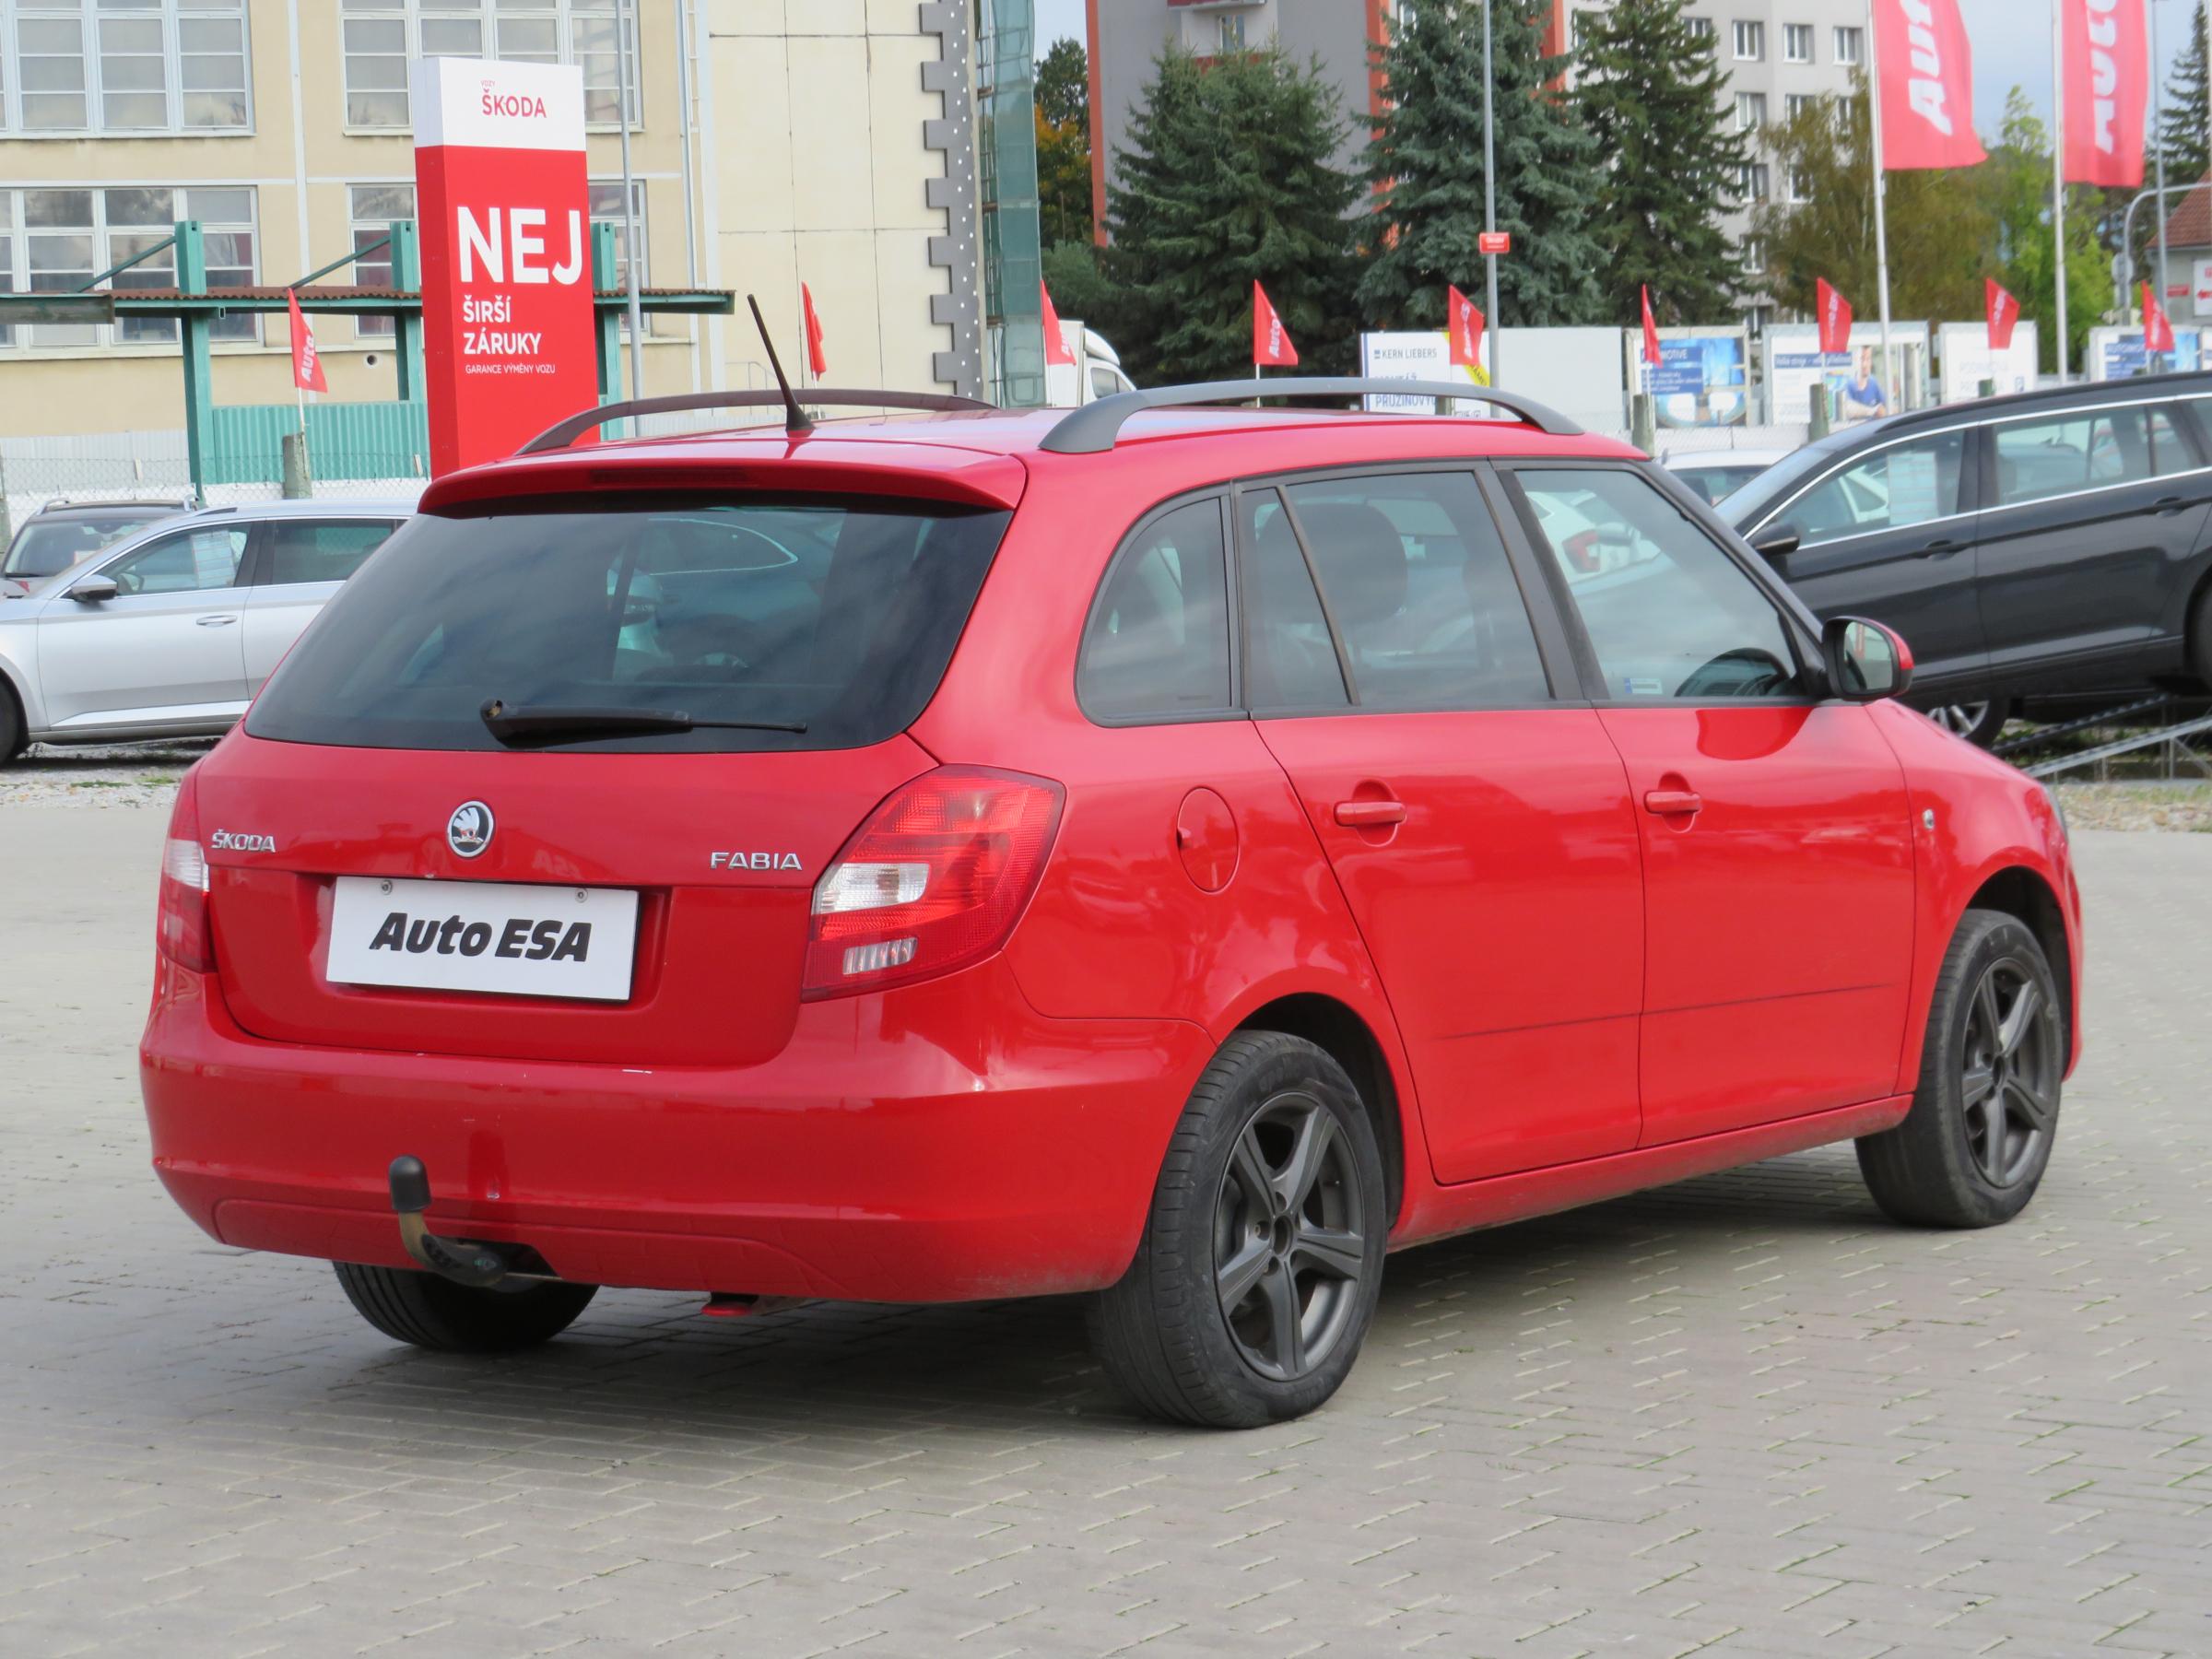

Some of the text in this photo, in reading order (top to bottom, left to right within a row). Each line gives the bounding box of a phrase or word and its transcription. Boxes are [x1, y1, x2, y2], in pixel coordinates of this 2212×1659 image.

[482, 88, 547, 118] ŠKODA
[457, 206, 582, 285] NEJ
[463, 294, 512, 324] ŠIRŠÍ
[463, 327, 542, 355] ZÁRUKY
[1382, 347, 1437, 359] KERN LIEBERS
[465, 362, 556, 374] GARANCE VÝMĚNY VOZU
[211, 829, 276, 853] ŠKODA
[711, 852, 803, 870] FABIA
[369, 912, 593, 962] Auto ESA
